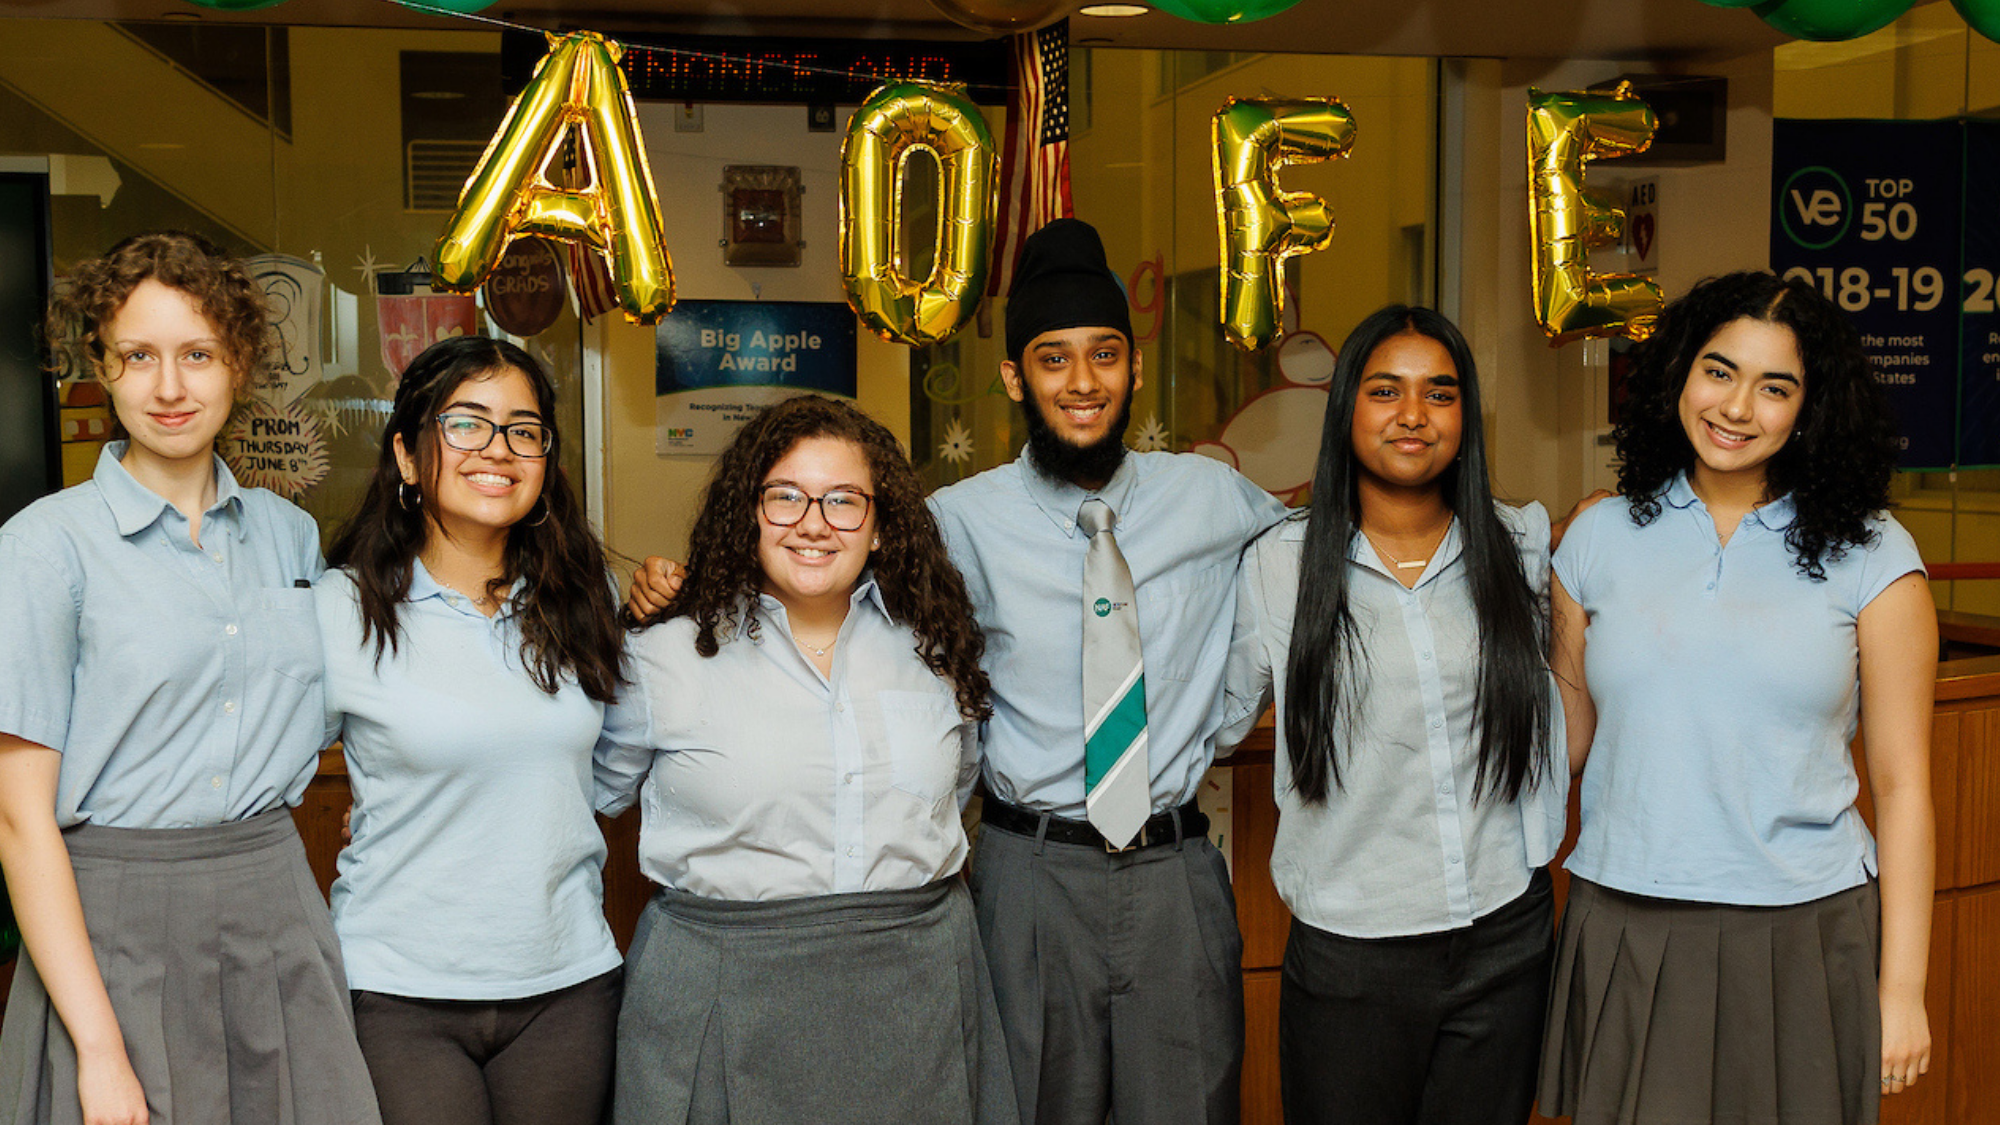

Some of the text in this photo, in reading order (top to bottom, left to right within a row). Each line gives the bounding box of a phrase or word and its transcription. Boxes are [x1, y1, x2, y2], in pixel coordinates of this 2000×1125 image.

[626, 49, 818, 91] INANCE
[1632, 183, 1655, 206] AED
[1865, 178, 1914, 198] TOP
[1860, 202, 1918, 241] 50
[492, 275, 549, 295] GRADS
[1769, 266, 1945, 312] 18-19
[701, 328, 822, 352] Big Apple
[1860, 333, 1925, 347] the most
[718, 353, 797, 372] Award
[1868, 352, 1930, 368] mpanies
[1873, 371, 1916, 384] States
[689, 402, 743, 412] Recognizing
[251, 417, 300, 436] PROM
[668, 428, 693, 437] NYC
[238, 440, 309, 455] THURSDAY
[245, 456, 286, 471] JUNE
